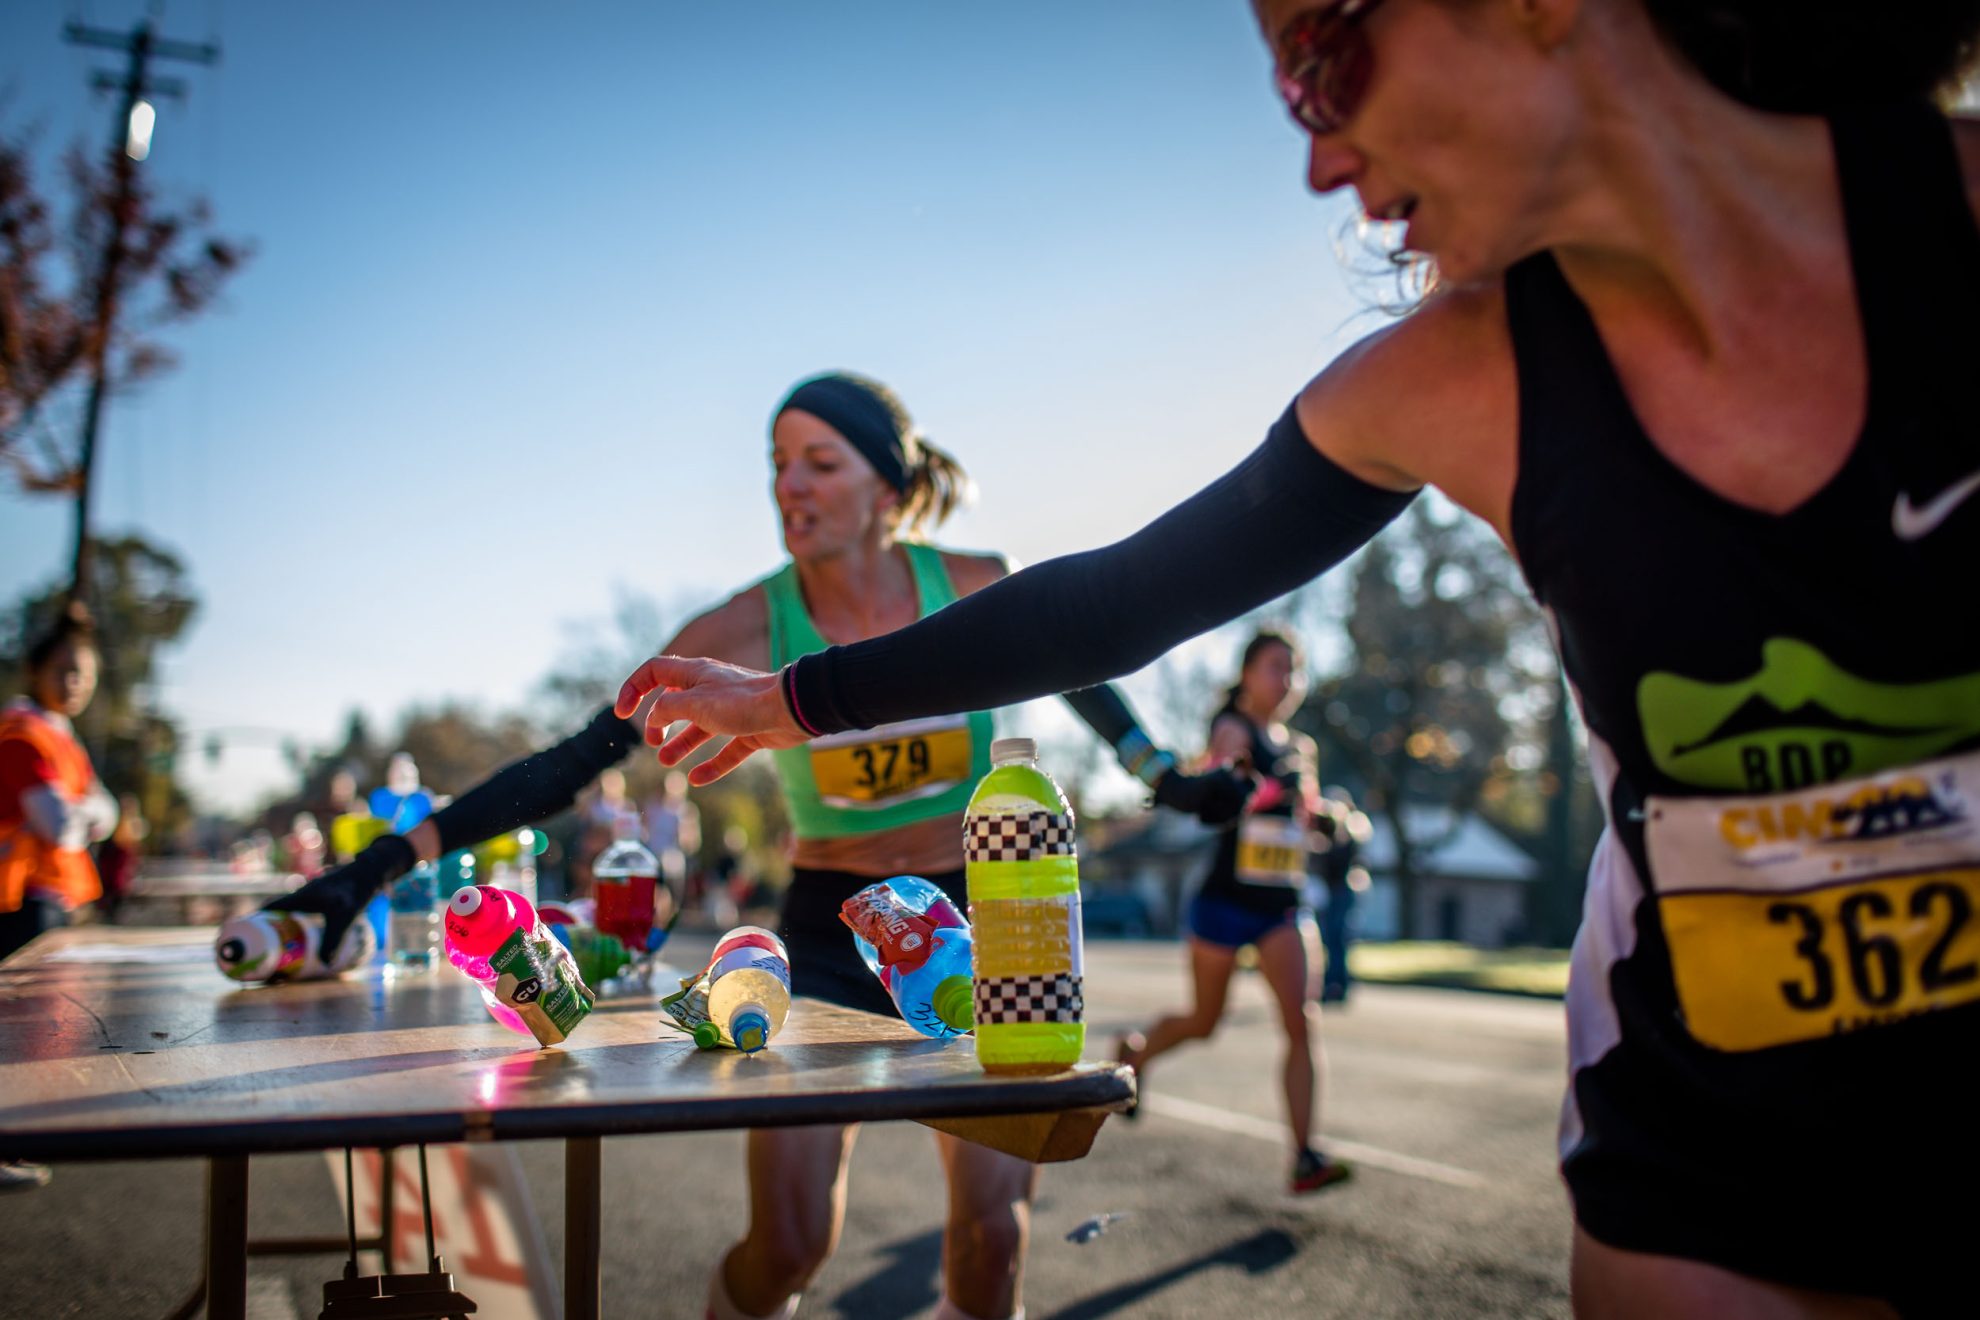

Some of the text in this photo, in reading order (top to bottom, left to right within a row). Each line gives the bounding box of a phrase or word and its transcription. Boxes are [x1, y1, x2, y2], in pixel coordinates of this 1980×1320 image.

[853, 739, 930, 787] 379
[496, 943, 519, 968] SALTED
[1767, 881, 1980, 1013] 362
[516, 980, 540, 1002] GU
